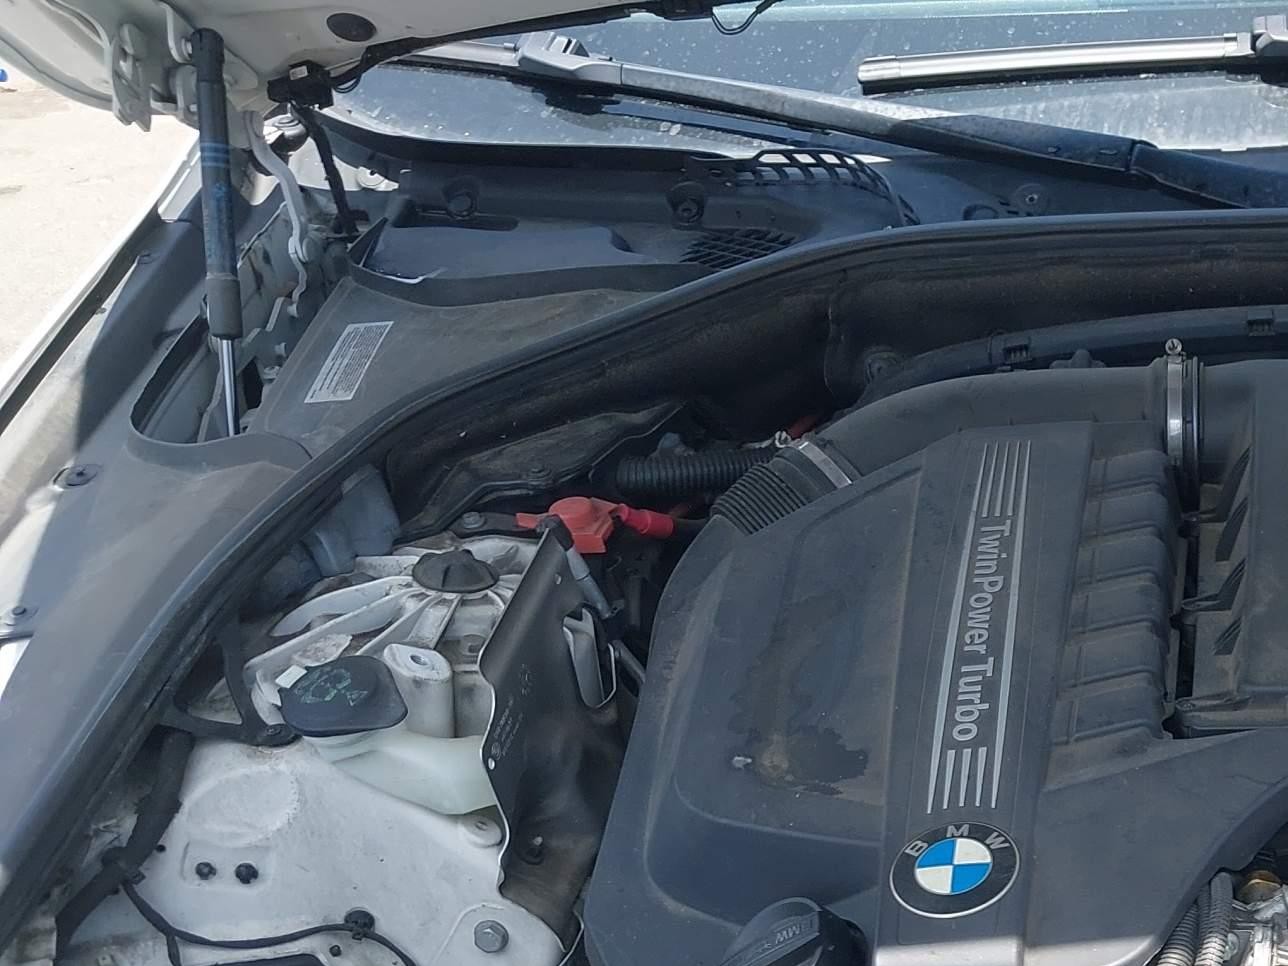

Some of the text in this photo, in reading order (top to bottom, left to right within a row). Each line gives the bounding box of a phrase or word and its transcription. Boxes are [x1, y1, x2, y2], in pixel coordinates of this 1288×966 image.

[952, 519, 1011, 743] TwinPower Turbo
[904, 823, 1011, 857] BMW
